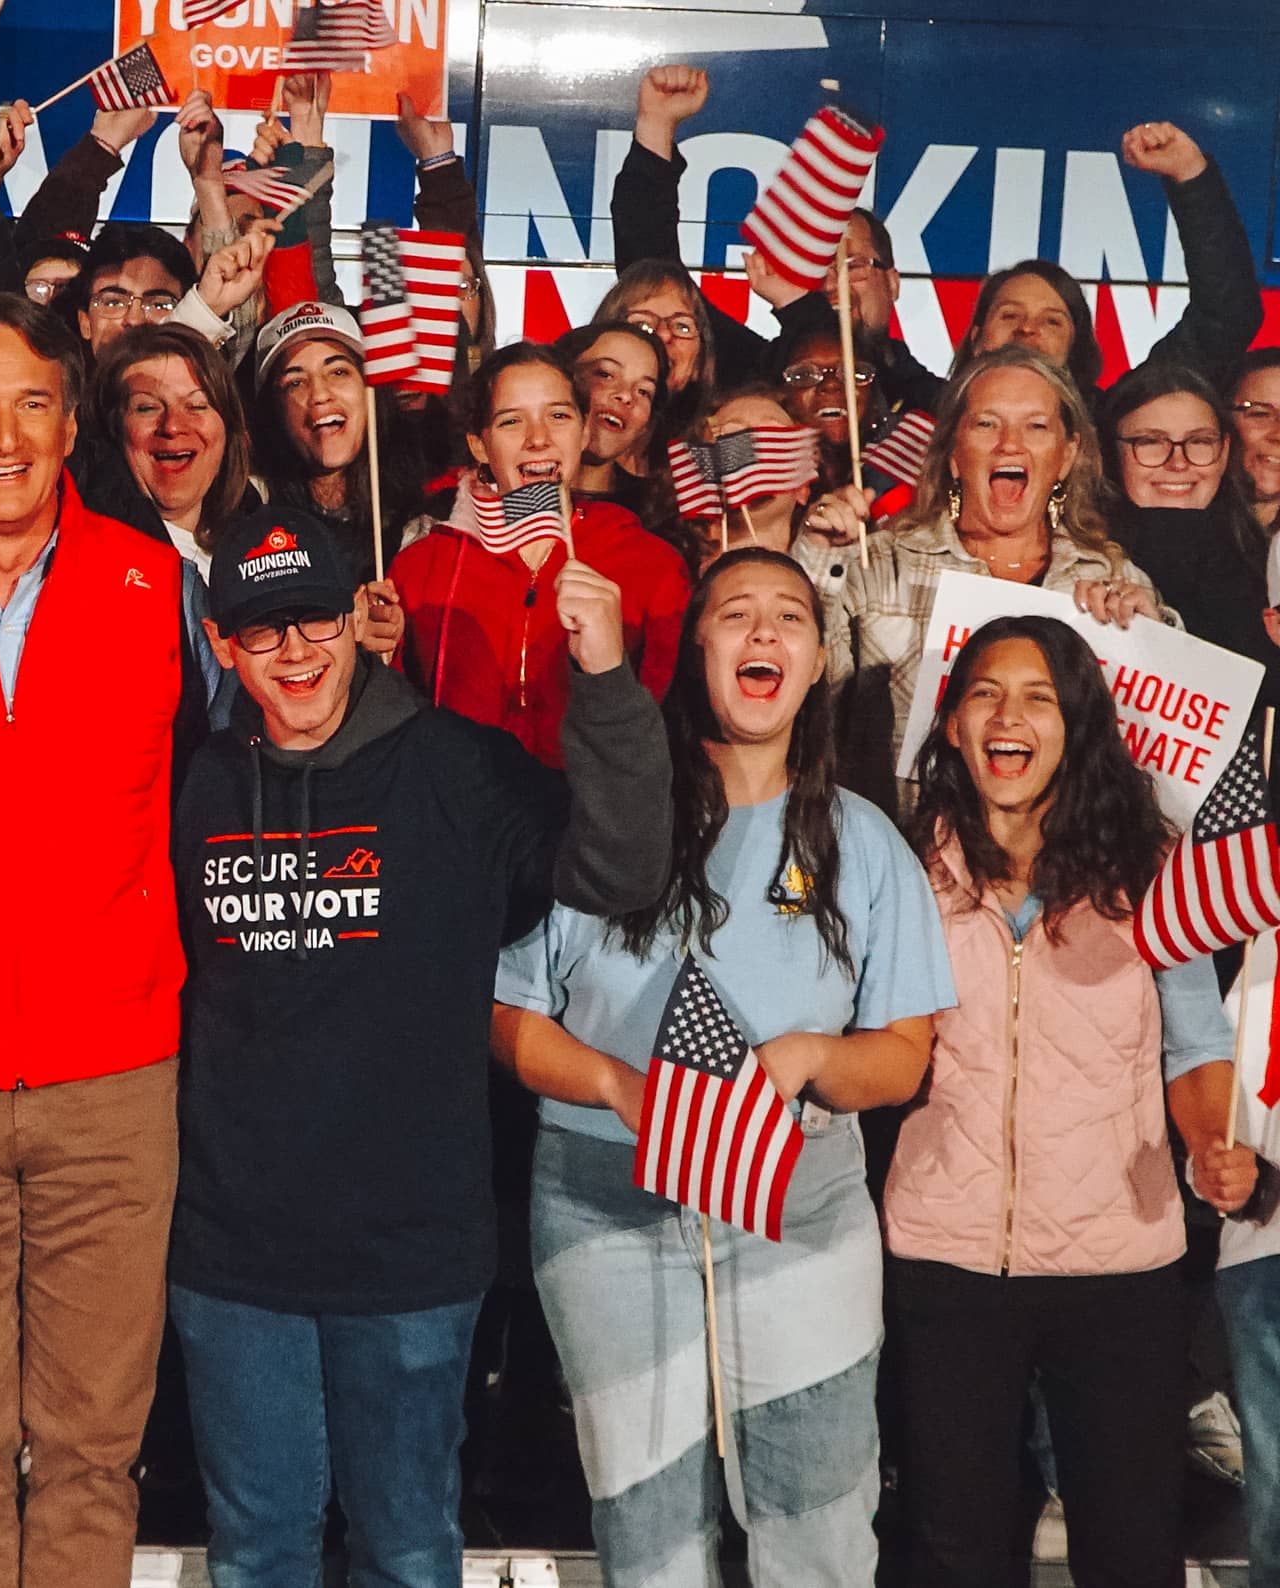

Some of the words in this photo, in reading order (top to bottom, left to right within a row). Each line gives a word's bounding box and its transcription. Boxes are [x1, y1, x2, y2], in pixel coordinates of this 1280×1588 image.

[190, 43, 372, 74] GOVER
[276, 315, 334, 338] YOUNGKIN
[238, 550, 311, 580] YOUNGKIN
[254, 567, 299, 583] GOVERNOR
[1111, 665, 1231, 741] HOUSE
[1117, 718, 1212, 786] NATE
[203, 850, 318, 887] SECURE
[203, 892, 286, 924] YOUR
[289, 887, 381, 919] VOTE
[239, 927, 335, 952] VIRGINIA
